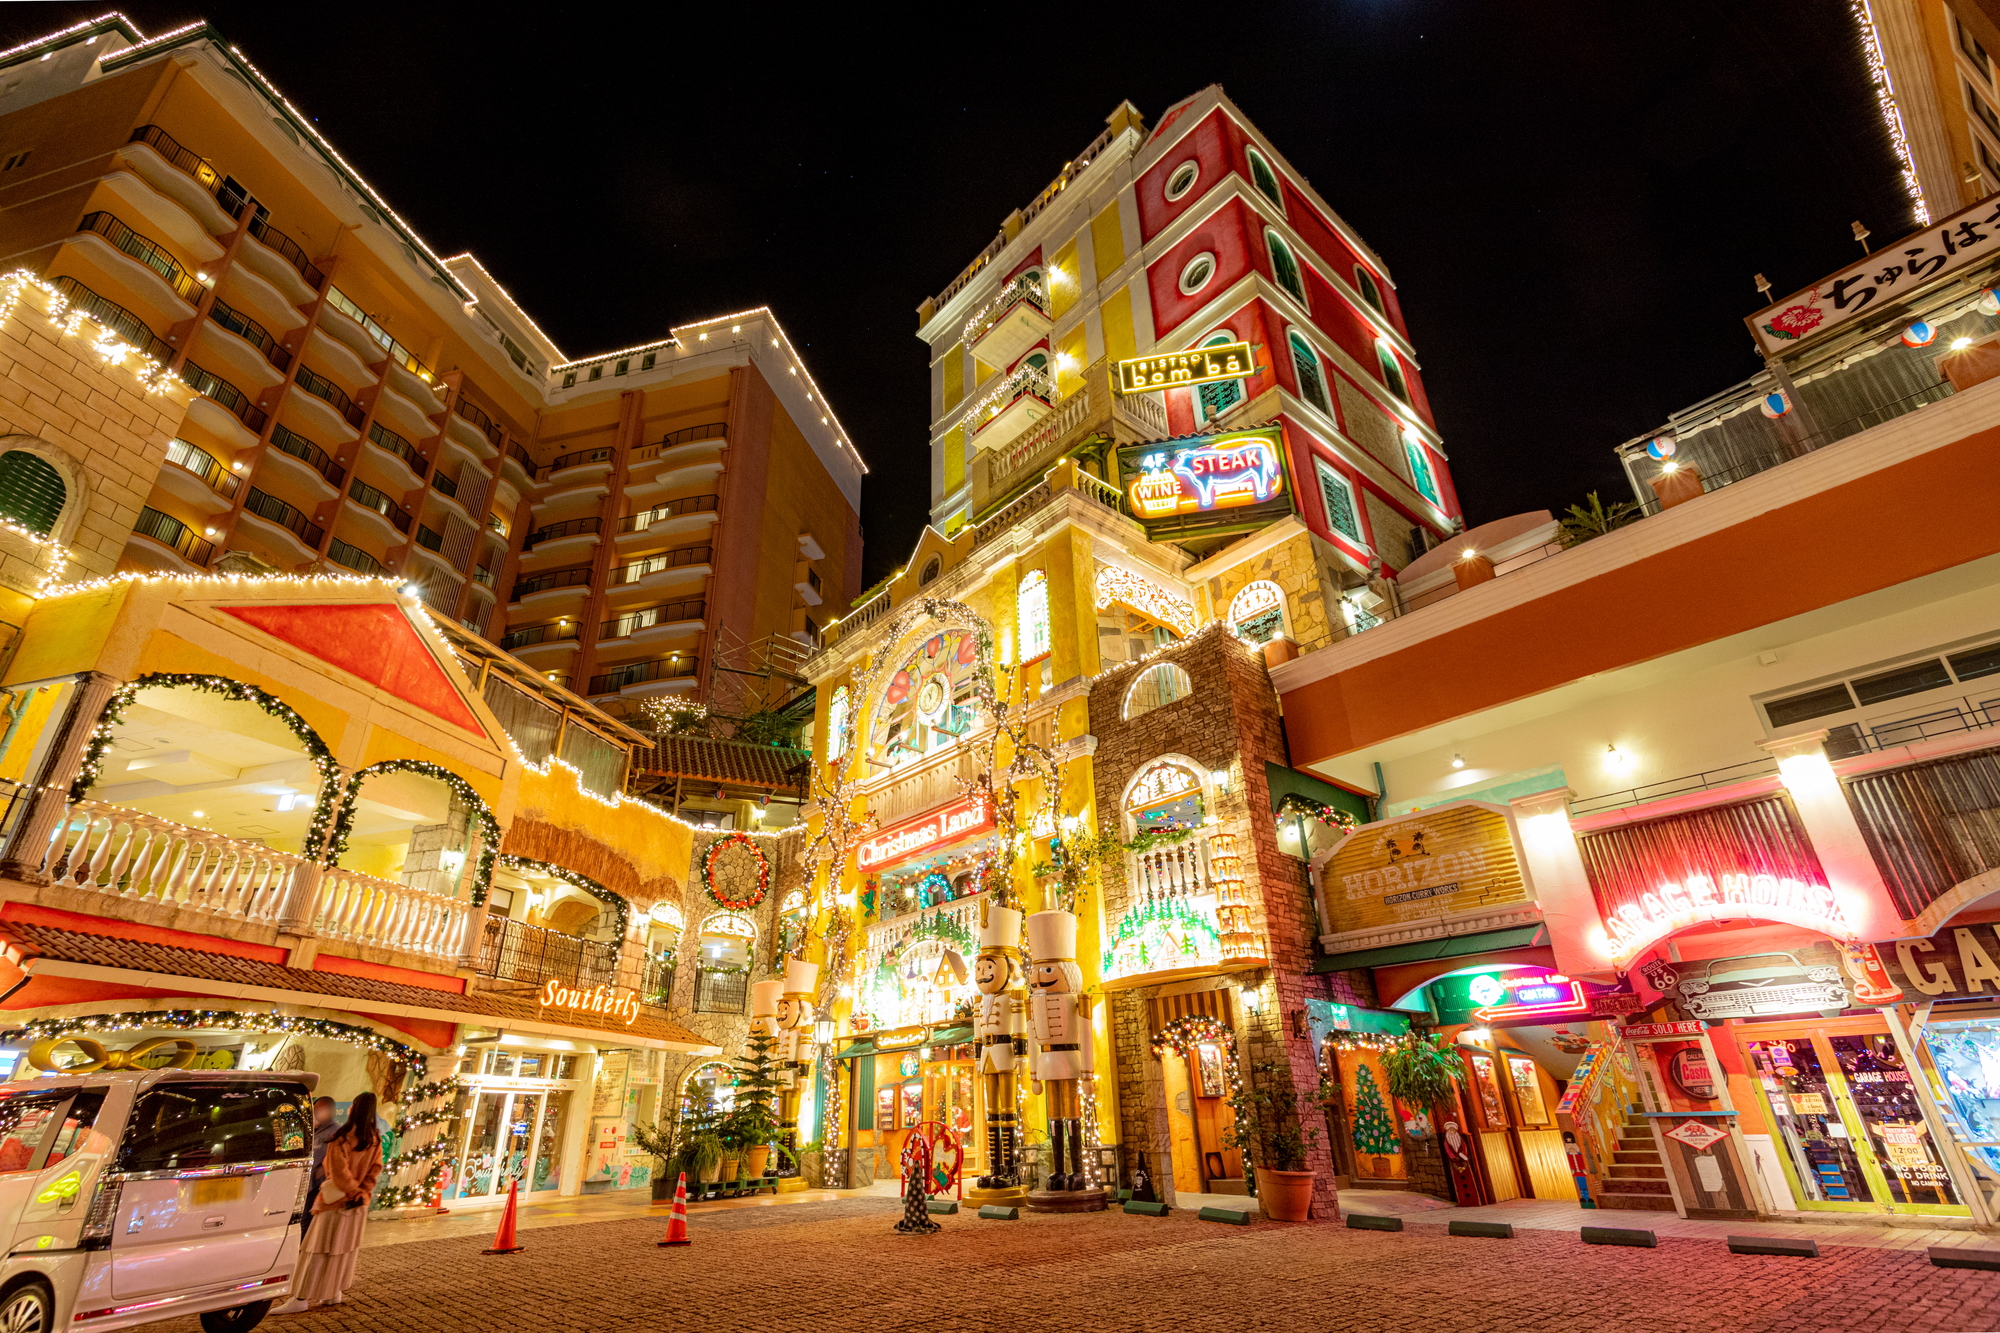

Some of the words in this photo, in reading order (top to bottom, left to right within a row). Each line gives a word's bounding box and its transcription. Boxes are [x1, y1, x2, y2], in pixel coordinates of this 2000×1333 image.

[1140, 354, 1200, 371] BISTRO
[1143, 453, 1166, 468] 4F
[1192, 449, 1261, 475] STEAK
[1138, 481, 1183, 499] WINE
[859, 823, 938, 866] Christmas
[940, 806, 985, 837] Land
[1342, 846, 1487, 899] HORIZON
[1384, 892, 1411, 905] HORIZON
[1411, 888, 1433, 900] CURRY
[1433, 883, 1459, 895] WORKS
[1392, 900, 1432, 914] RESTAURANT
[1441, 896, 1454, 905] BAR
[1400, 912, 1411, 920] AT
[1413, 906, 1450, 919] CHATAN
[1607, 876, 1719, 957] GARAGE
[1722, 873, 1852, 933] HOUSE
[1642, 960, 1663, 973] ROUTE
[1896, 923, 2000, 995] GA
[1651, 968, 1664, 977] US
[1654, 972, 1675, 989] 66
[540, 980, 641, 1025] Southerly
[1519, 988, 1556, 1001] CHATAN
[1652, 1024, 1674, 1034] SOLD
[1676, 1021, 1699, 1033] HERE
[1853, 1071, 1884, 1083] GARAGE
[1883, 1070, 1909, 1082] HOUSE
[1693, 1086, 1710, 1094] HERE
[1886, 1133, 1917, 1144] CLOSED
[1893, 1164, 1909, 1172] NO
[1911, 1164, 1943, 1172] FOOD
[1915, 1172, 1949, 1180] DRINK
